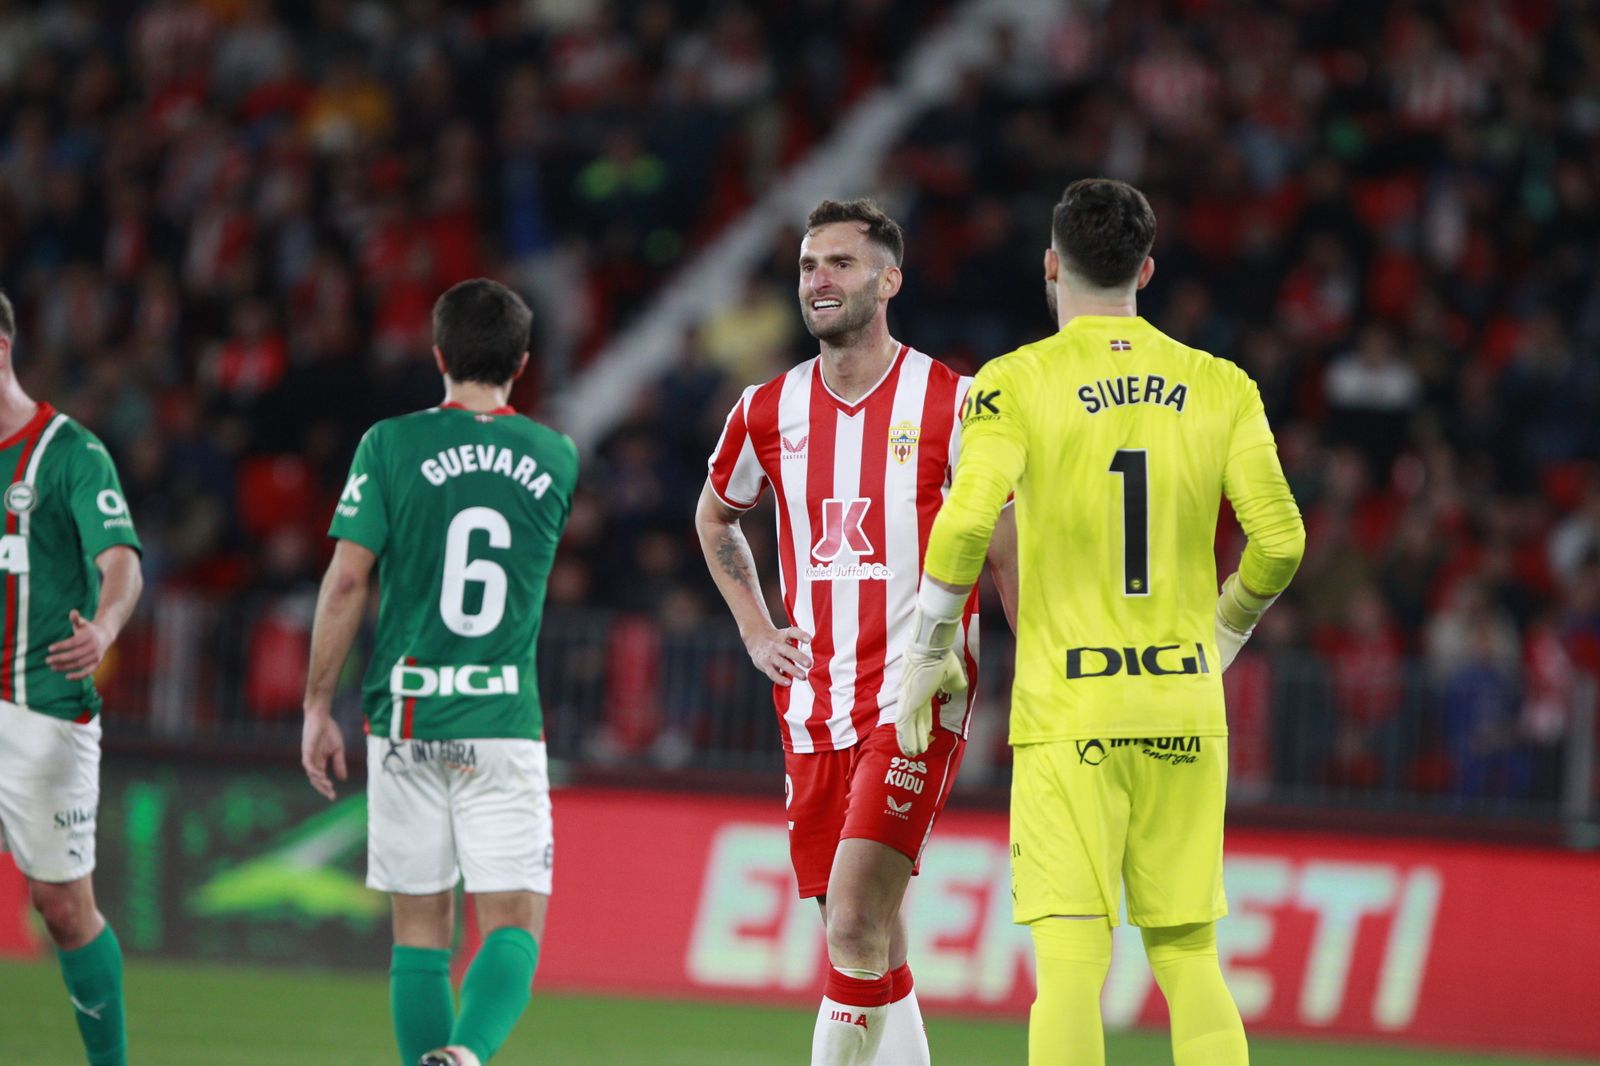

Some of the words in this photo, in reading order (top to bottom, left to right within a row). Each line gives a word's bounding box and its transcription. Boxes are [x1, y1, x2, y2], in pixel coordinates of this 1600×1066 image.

[1078, 374, 1188, 414] SIVERA
[420, 444, 553, 500] GUEVARA
[811, 498, 874, 562] JK
[1107, 448, 1150, 597] 1
[439, 506, 512, 638] 6
[805, 565, 833, 577] Khaled
[836, 565, 869, 577] Juffali
[872, 566, 892, 577] Co.
[389, 664, 519, 698] DIGI
[1066, 642, 1210, 680] DIGI
[884, 768, 924, 795] KUDU
